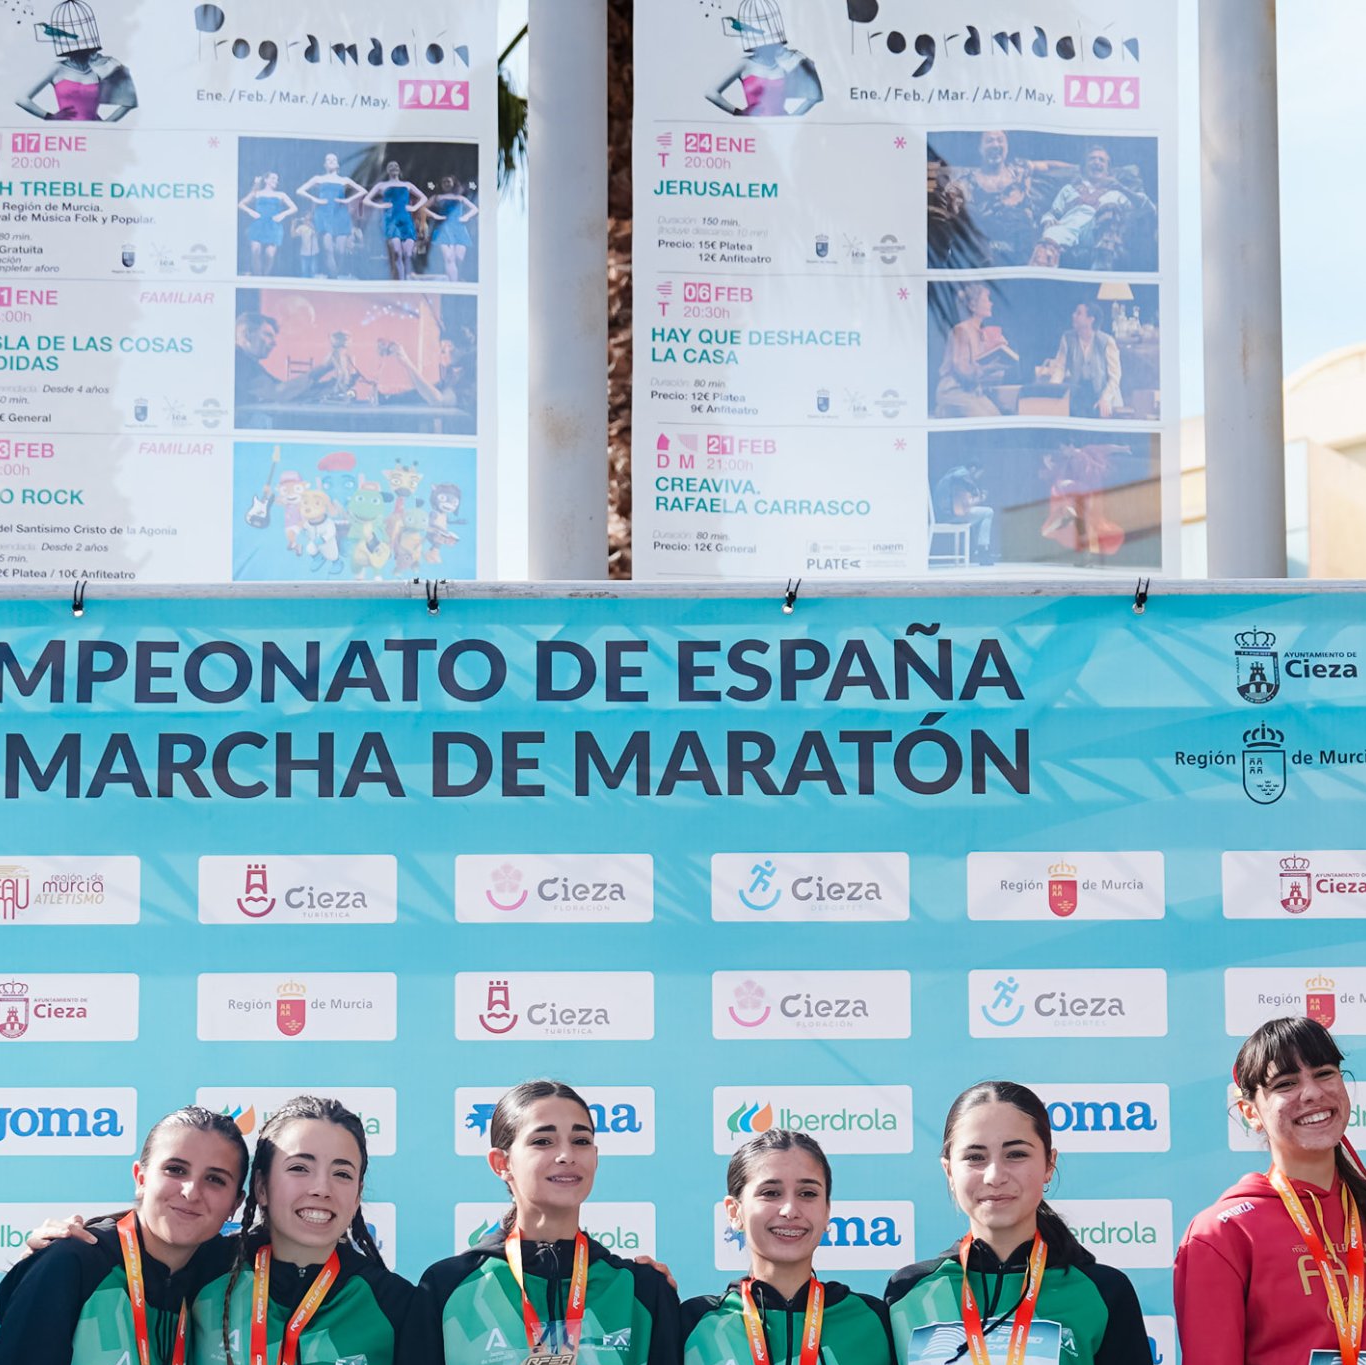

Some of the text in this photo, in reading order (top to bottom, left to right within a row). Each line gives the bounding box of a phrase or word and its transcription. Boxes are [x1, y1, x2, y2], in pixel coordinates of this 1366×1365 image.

[403, 83, 465, 107] 2026
[1069, 79, 1135, 106] 2026
[13, 134, 88, 152] 17 ENE
[685, 134, 756, 153] 24 ENE
[11, 156, 60, 169] 20:00h
[684, 156, 732, 169] 20:00h
[21, 181, 104, 198] TREBLE
[110, 182, 215, 199] DANCERS
[653, 179, 778, 198] JERUSALEM
[2, 201, 41, 213] Región
[44, 202, 59, 212] de
[62, 203, 104, 213] Murcia.
[14, 213, 28, 222] de
[31, 212, 71, 223] Música
[75, 213, 98, 223] Folk
[658, 239, 753, 251] Precio: 15€ Platea
[698, 253, 718, 263] 12€
[16, 290, 58, 305] ENE
[139, 291, 215, 305] FAMILIAR
[684, 283, 753, 302] 06 FEB
[683, 306, 730, 319] 20:30h
[37, 335, 65, 351] DE
[72, 336, 113, 352] LAS
[119, 337, 194, 353] COSAS
[651, 327, 861, 347] HAY QUE DESHACER
[651, 347, 739, 365] LA CASA
[14, 443, 55, 458] FEB
[138, 442, 214, 455] FAMILIAR
[738, 439, 777, 455] FEB
[655, 476, 761, 495] CREAVIVA.
[22, 489, 84, 505] ROCK
[655, 496, 871, 516] RAFAELA CARRASCO
[73, 525, 107, 535] Cristo
[110, 526, 123, 535] de
[12, 569, 47, 579] Platea
[536, 639, 649, 703] DE
[678, 622, 1026, 702] ESPAÑA
[1283, 651, 1358, 659] AYUNTAMIENTO DE
[1284, 659, 1359, 680] Cieza
[4, 730, 406, 800] MARCHA
[432, 729, 546, 798] DE
[575, 711, 1032, 797] MARATÓN
[1174, 749, 1237, 769] Región
[1291, 749, 1315, 767] de
[42, 876, 104, 894] murcia
[91, 872, 104, 882] de
[537, 876, 627, 902] Cieza
[791, 875, 883, 901] Cieza
[999, 879, 1144, 894] Región de Murcia
[33, 893, 106, 905] ATLETISMO
[284, 886, 368, 910] Cieza
[302, 910, 351, 918] TURÍSTICA
[227, 997, 374, 1013] Región de Murcia
[779, 993, 869, 1018] Cieza
[1034, 991, 1126, 1018] Cieza
[1257, 993, 1302, 1008] Región
[1339, 993, 1356, 1005] de
[33, 1003, 88, 1019] Cieza
[527, 1002, 611, 1026] Cieza
[778, 1107, 897, 1132] Iberdrola
